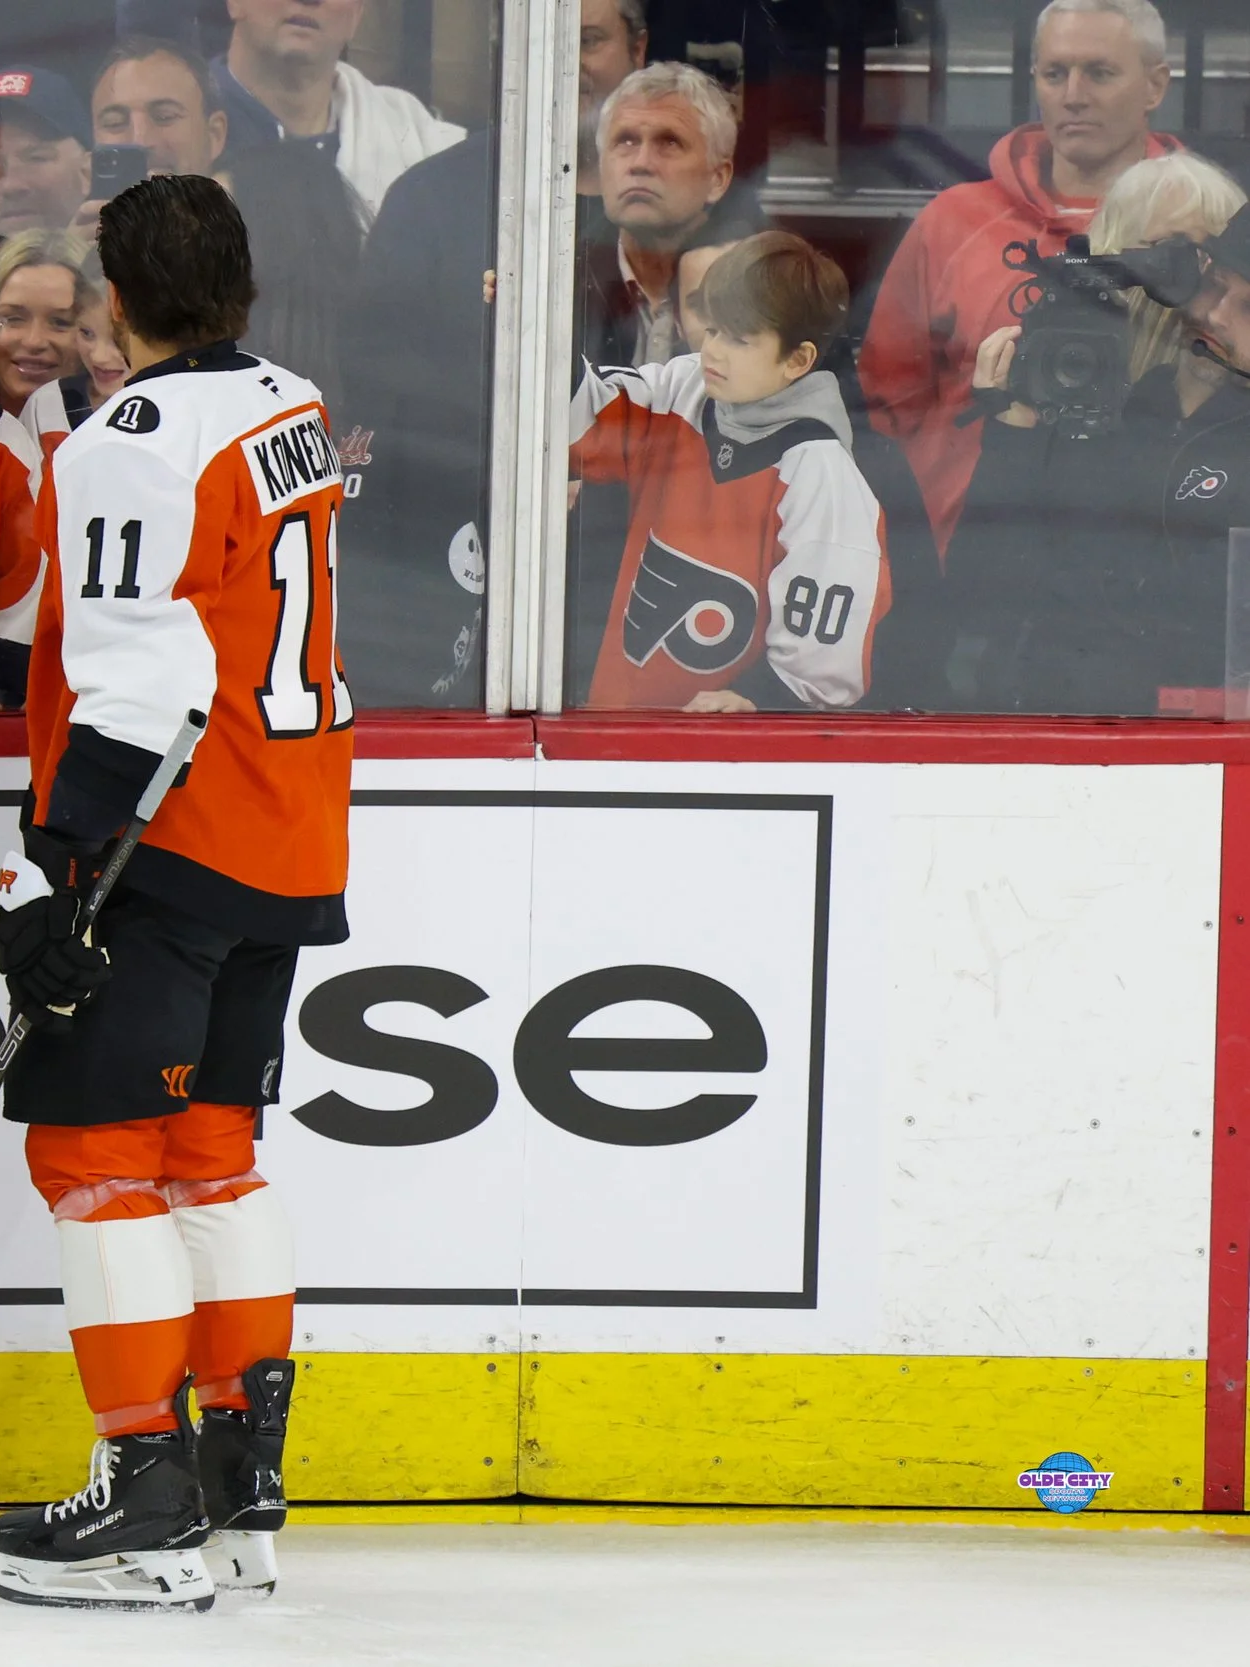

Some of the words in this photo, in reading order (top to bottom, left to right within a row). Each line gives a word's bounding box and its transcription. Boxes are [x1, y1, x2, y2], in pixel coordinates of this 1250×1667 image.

[117, 400, 143, 431] 1
[253, 417, 341, 502] KONECN
[81, 517, 142, 599] 11
[783, 574, 855, 645] 80
[102, 838, 134, 886] NEXUS
